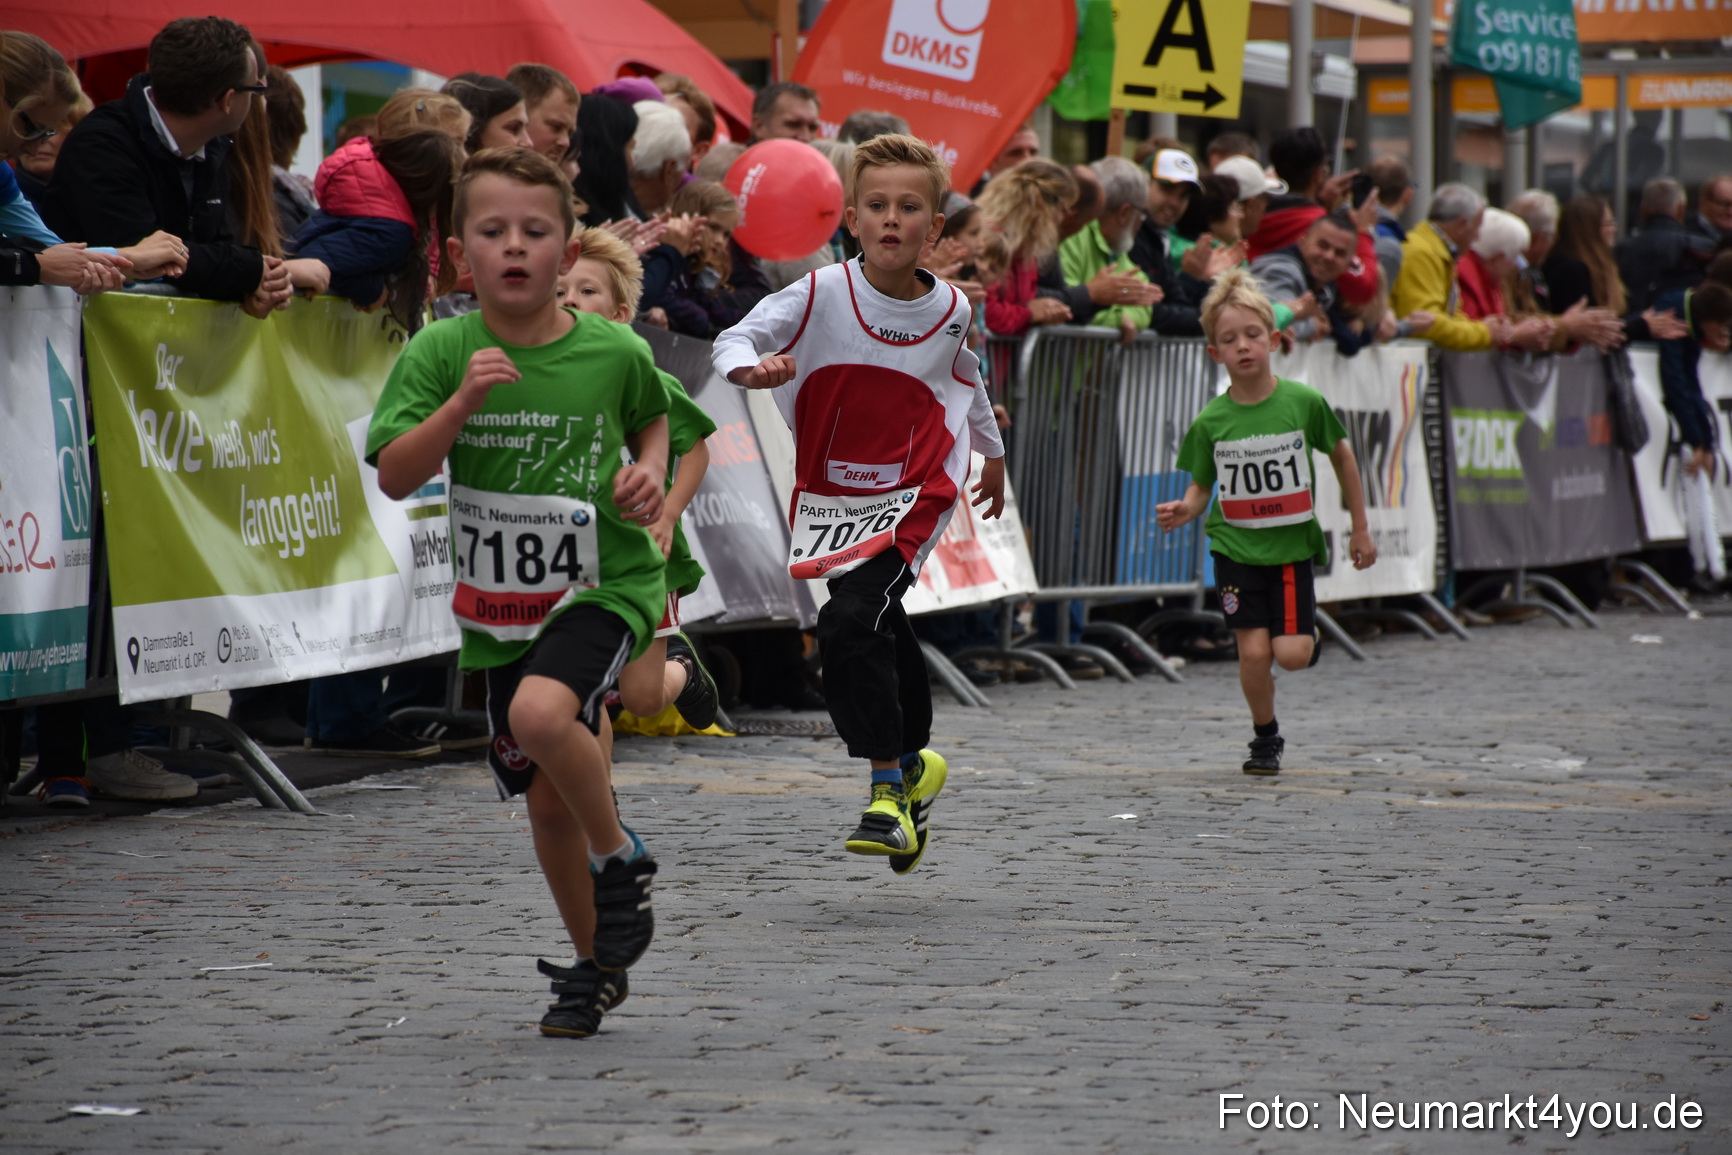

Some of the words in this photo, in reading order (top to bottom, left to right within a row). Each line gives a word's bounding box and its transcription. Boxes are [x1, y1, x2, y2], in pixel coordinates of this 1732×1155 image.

[1143, 0, 1216, 73] A
[892, 31, 969, 71] DKMS
[1479, 38, 1560, 78] 09181
[842, 69, 866, 87] Wir
[867, 75, 931, 101] besiegen
[931, 88, 1002, 118] Blutkrebs.
[879, 327, 920, 342] WHAT
[155, 343, 184, 390] Der
[466, 410, 560, 428] eumarkter
[249, 417, 281, 465] wo's
[455, 431, 537, 453] Stadtlauf
[1215, 449, 1242, 460] PARTL
[1244, 443, 1290, 459] Neumarkt
[843, 470, 880, 482] DEHN
[1223, 454, 1301, 496] 7061
[239, 474, 341, 559] langgeht!
[452, 498, 486, 521] PARTL
[488, 508, 566, 526] Neumarkt
[799, 504, 843, 519] PARTL
[844, 497, 899, 518] Neumarkt
[1251, 503, 1284, 517] Leon
[806, 507, 901, 558] 7076
[460, 523, 584, 586] 7184
[815, 549, 861, 572] Simon
[143, 632, 189, 653] Dammstraße
[189, 631, 195, 647] 1
[144, 654, 178, 675] Neumarkt
